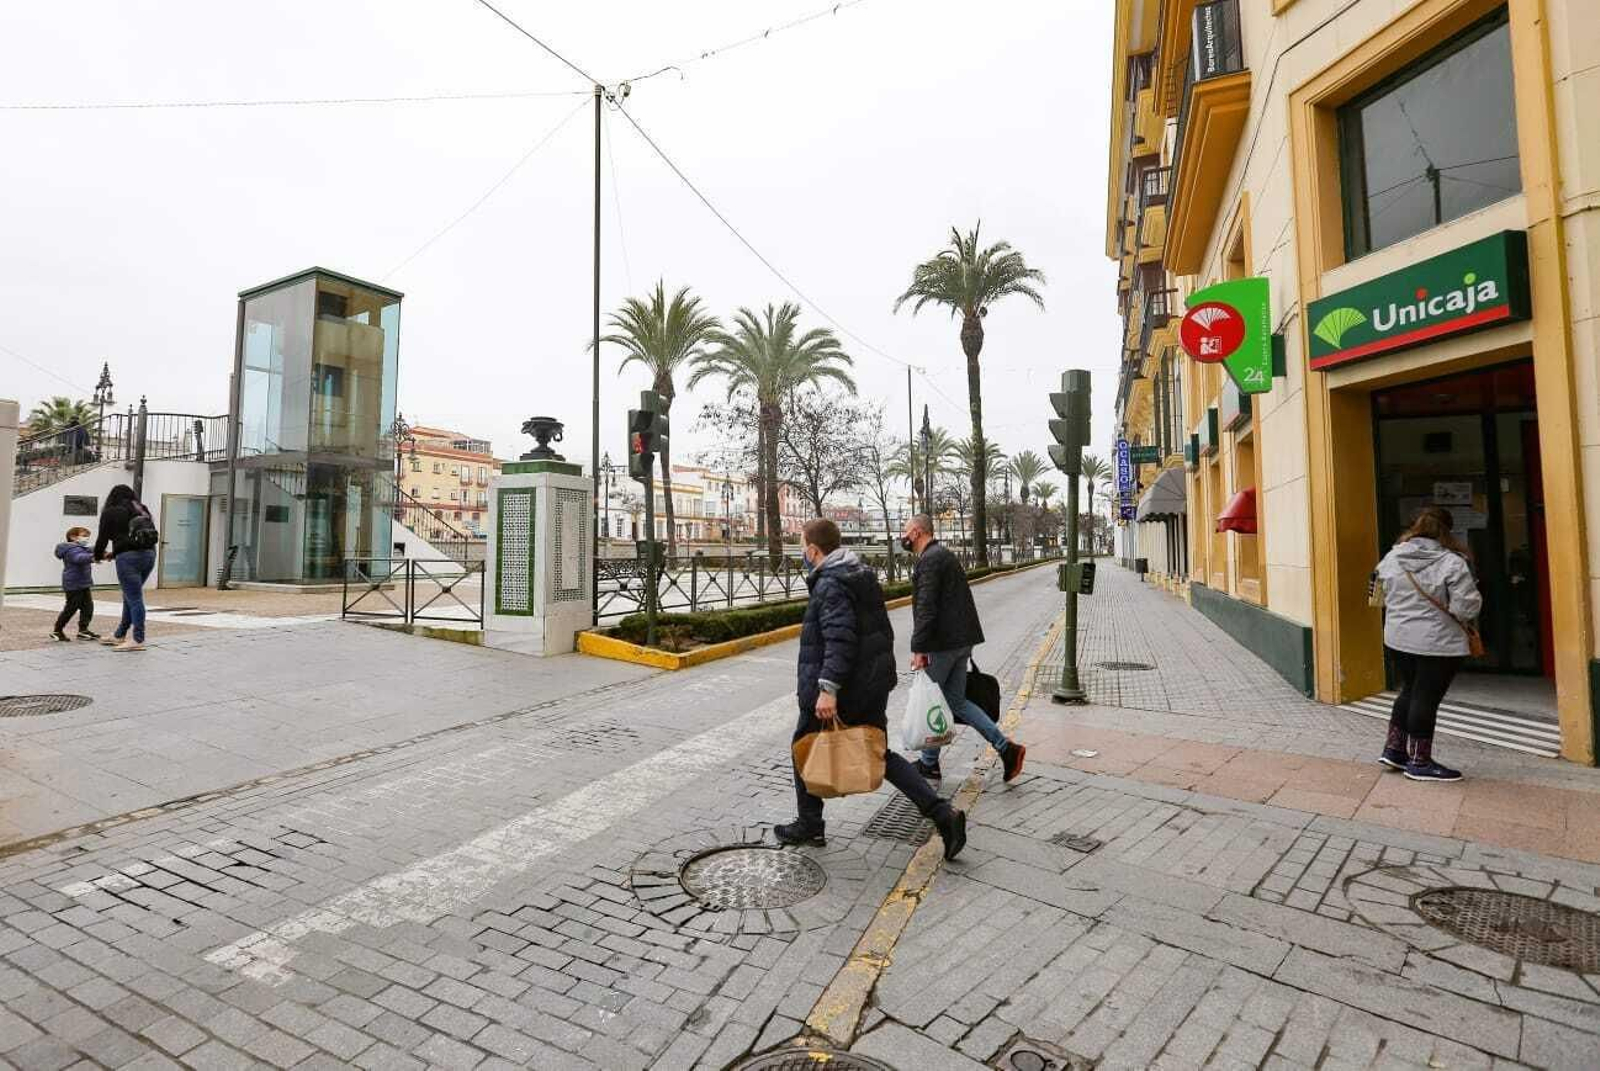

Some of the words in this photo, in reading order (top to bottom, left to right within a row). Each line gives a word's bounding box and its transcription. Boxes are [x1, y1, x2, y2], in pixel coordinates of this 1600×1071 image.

[1372, 272, 1499, 331] Unicaja
[1243, 366, 1264, 385] 24
[1119, 441, 1129, 483] OCASO
